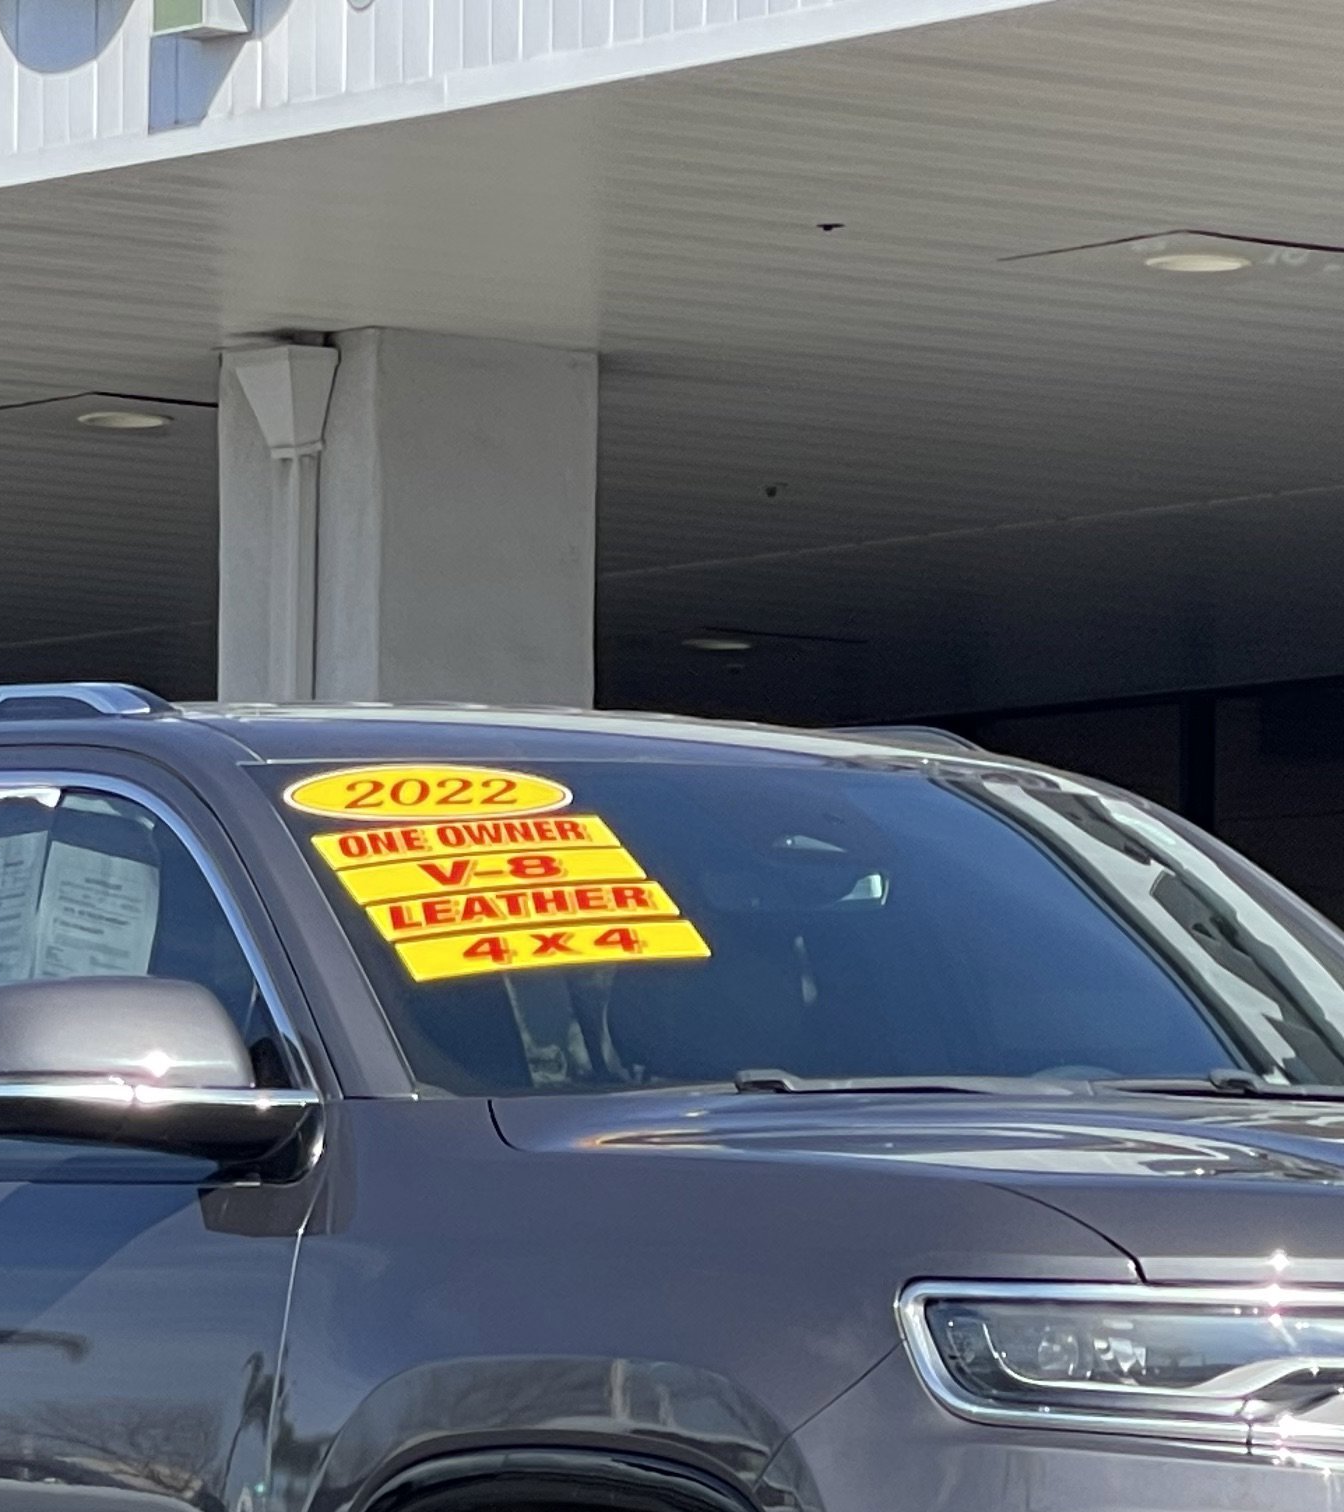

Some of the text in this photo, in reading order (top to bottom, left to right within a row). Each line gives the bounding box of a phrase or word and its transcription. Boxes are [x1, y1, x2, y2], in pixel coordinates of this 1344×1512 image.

[344, 777, 518, 809] 2022
[338, 819, 587, 858] ONE OWNER
[417, 855, 564, 886] V-8
[389, 886, 651, 931] LEATHER
